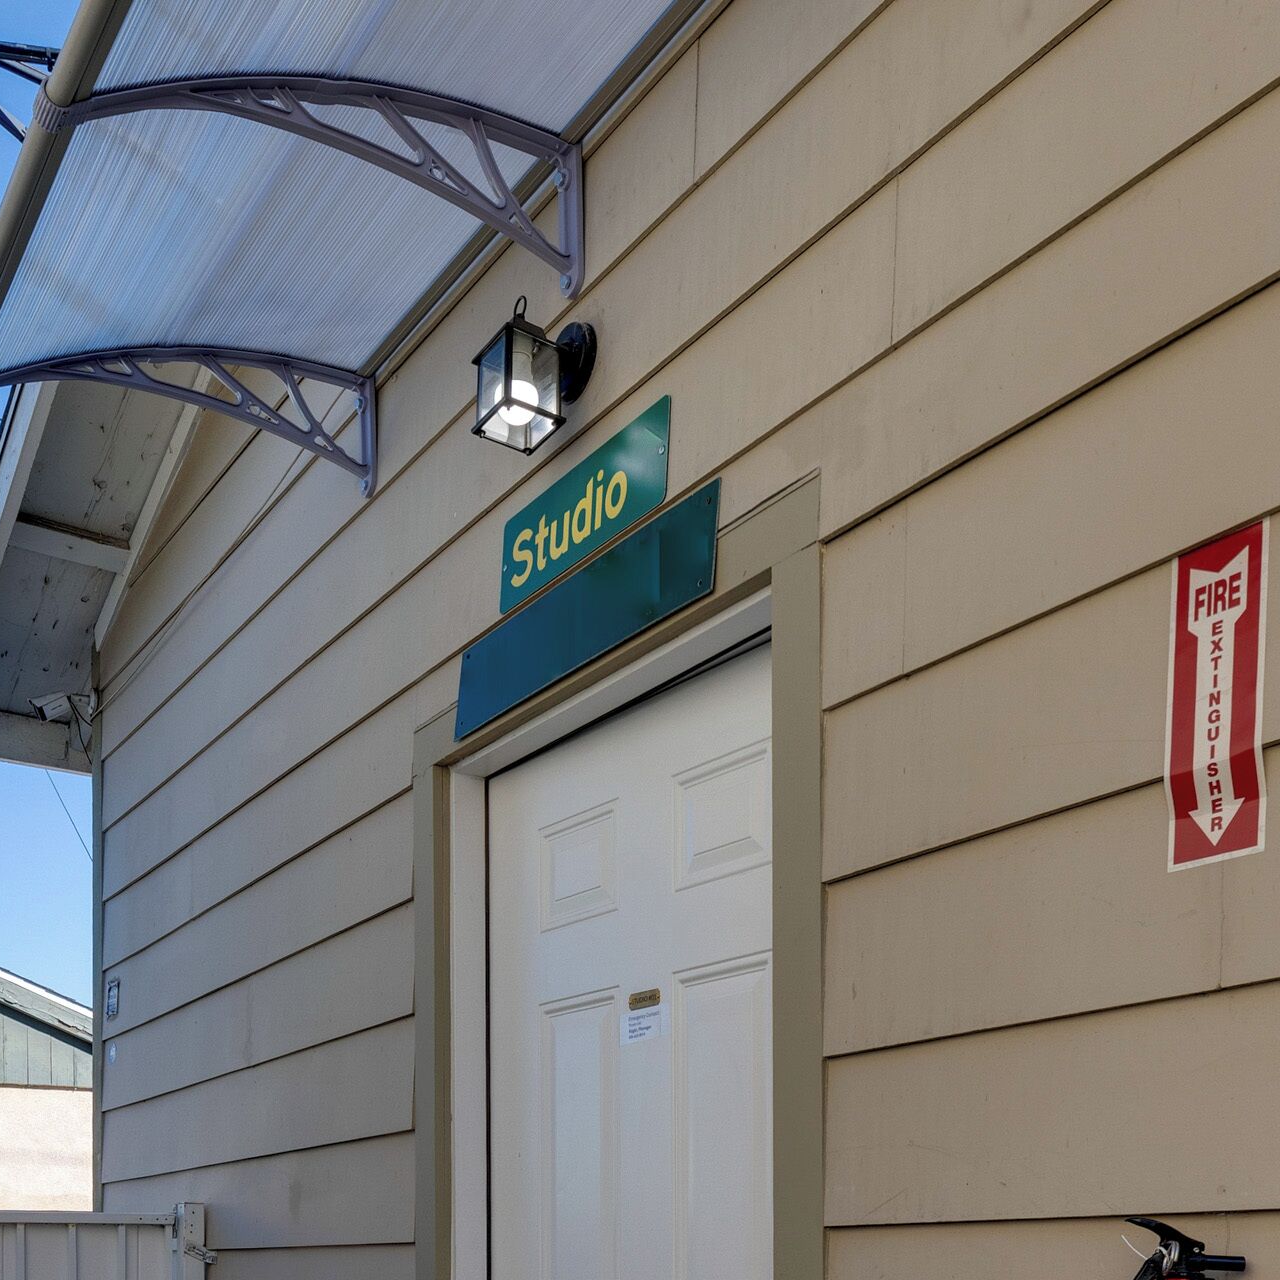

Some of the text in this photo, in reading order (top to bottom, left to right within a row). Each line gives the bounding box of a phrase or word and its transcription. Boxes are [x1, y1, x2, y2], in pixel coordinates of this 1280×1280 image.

[510, 469, 628, 588] Studio
[1193, 571, 1242, 623] FIRE
[1206, 619, 1224, 833] EXTINGUISHER
